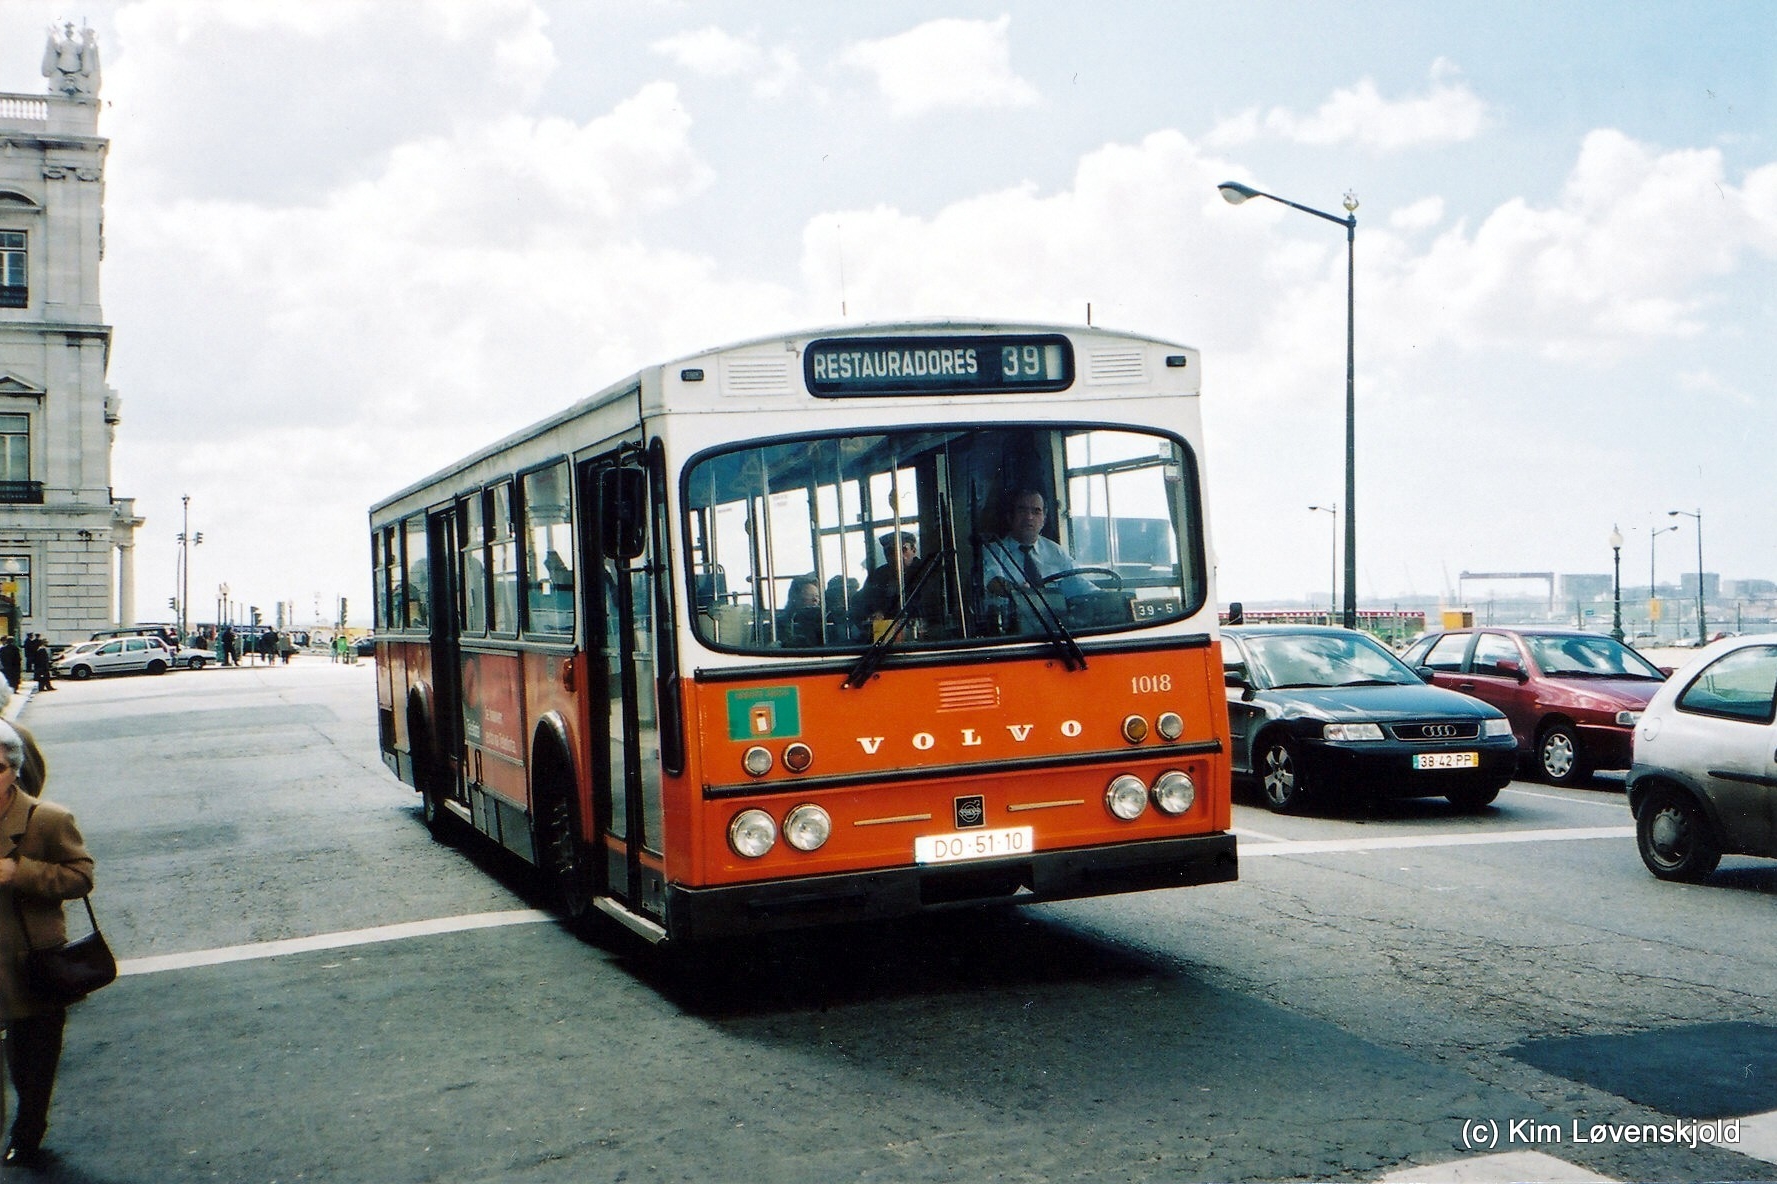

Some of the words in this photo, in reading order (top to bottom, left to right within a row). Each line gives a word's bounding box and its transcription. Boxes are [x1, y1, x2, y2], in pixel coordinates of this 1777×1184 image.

[813, 348, 978, 380] RESTAURADORES
[1003, 345, 1040, 376] 39
[1131, 673, 1172, 694] 1018
[856, 719, 1083, 755] VOLVO
